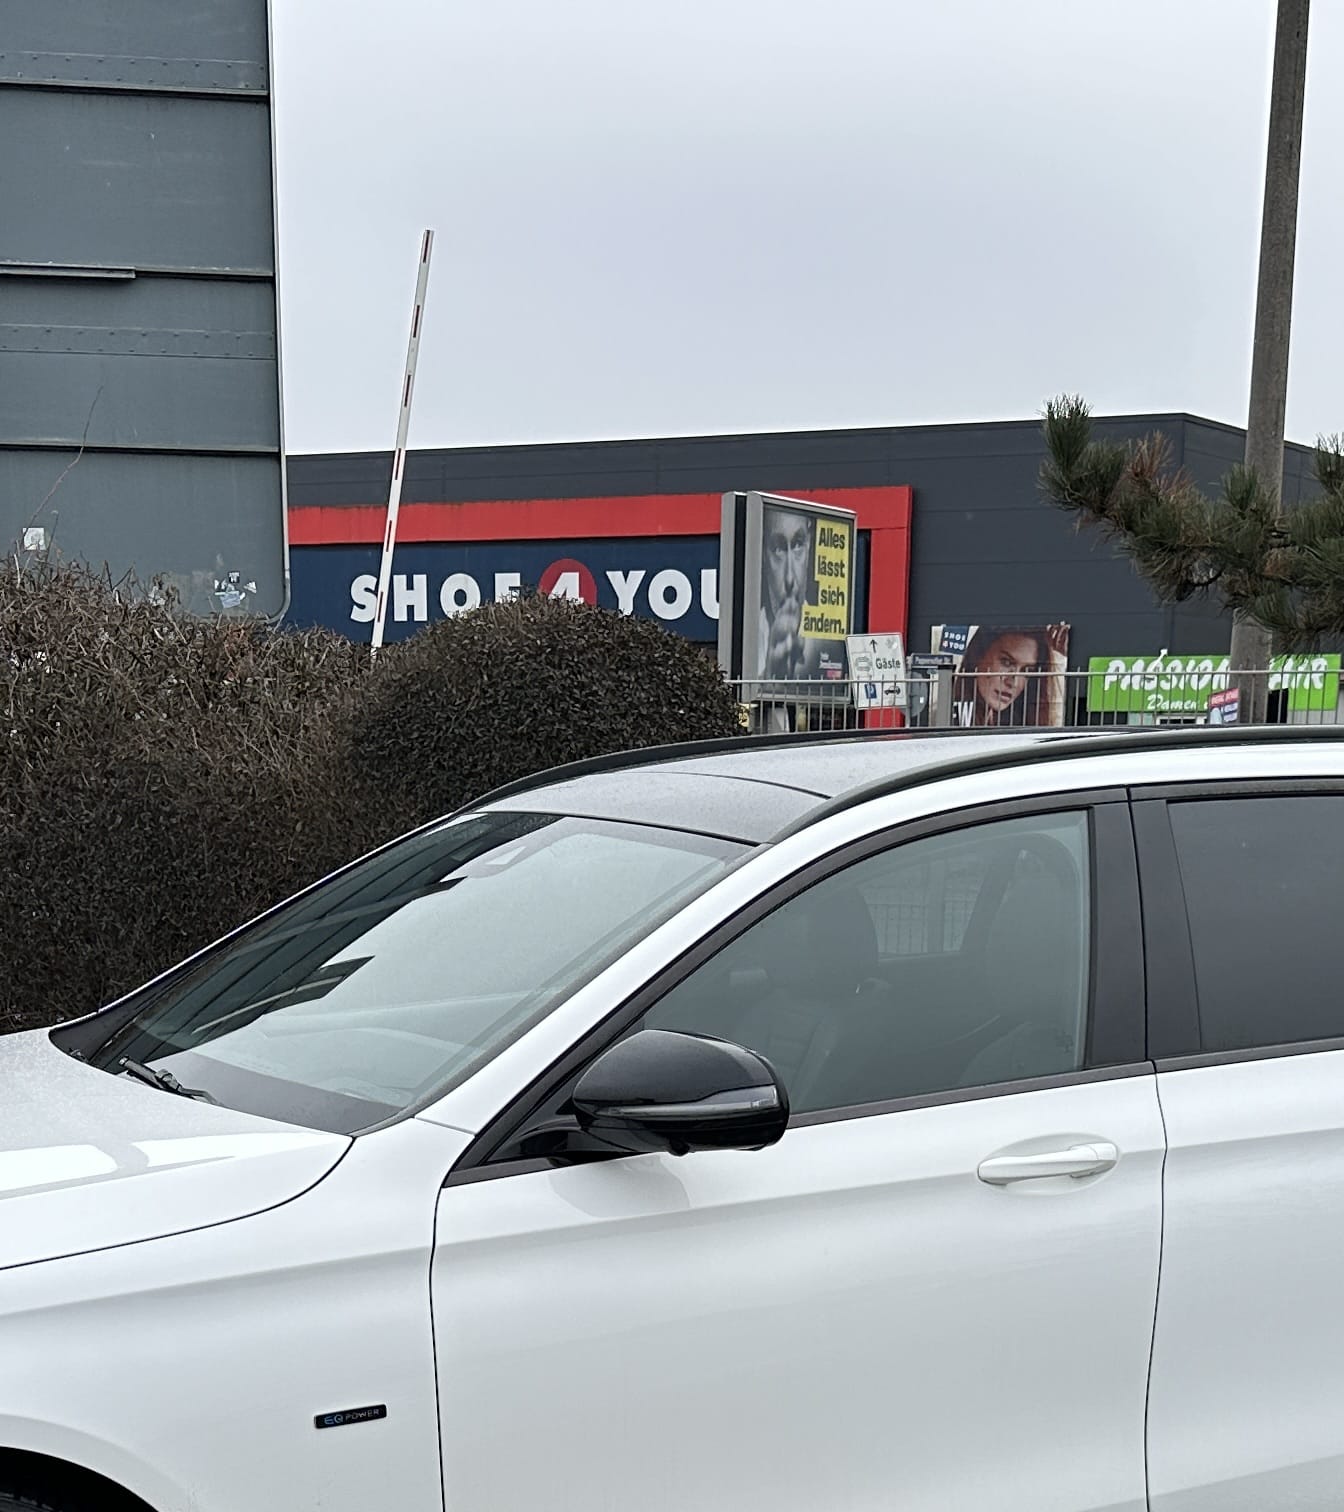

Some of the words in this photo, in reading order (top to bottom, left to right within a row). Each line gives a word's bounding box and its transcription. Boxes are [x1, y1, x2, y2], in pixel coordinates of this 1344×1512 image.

[818, 527, 845, 550] Alles
[817, 554, 846, 578] lässt
[820, 586, 845, 607] sich
[803, 611, 846, 635] ändern.
[875, 656, 901, 670] Gäste
[1147, 694, 1197, 710] Damen
[324, 1414, 344, 1425] EQ
[345, 1408, 380, 1420] POWER
